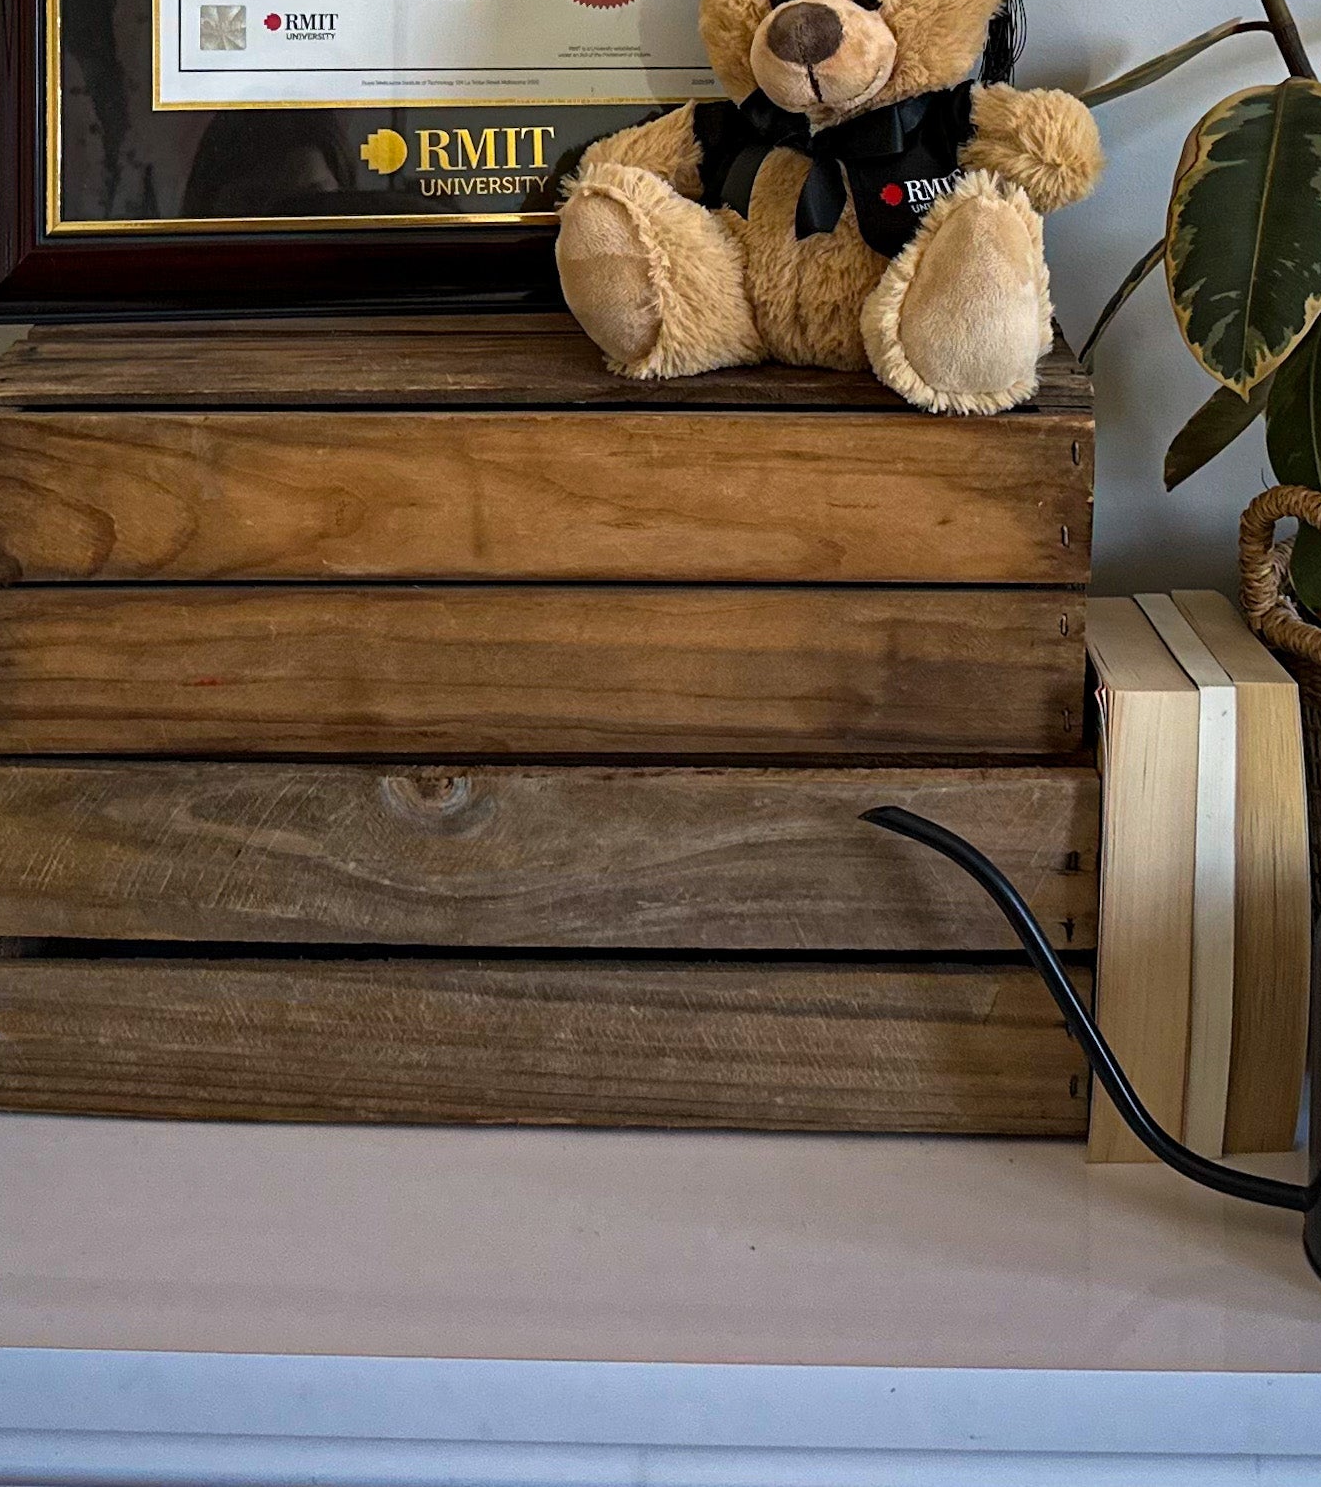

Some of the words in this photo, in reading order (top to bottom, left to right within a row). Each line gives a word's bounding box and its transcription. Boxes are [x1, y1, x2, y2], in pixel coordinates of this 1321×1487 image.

[284, 13, 339, 31] RMIT
[286, 32, 336, 41] UNIVERSITY
[414, 126, 555, 171] RMIT
[420, 175, 549, 196] UNIVERSITY
